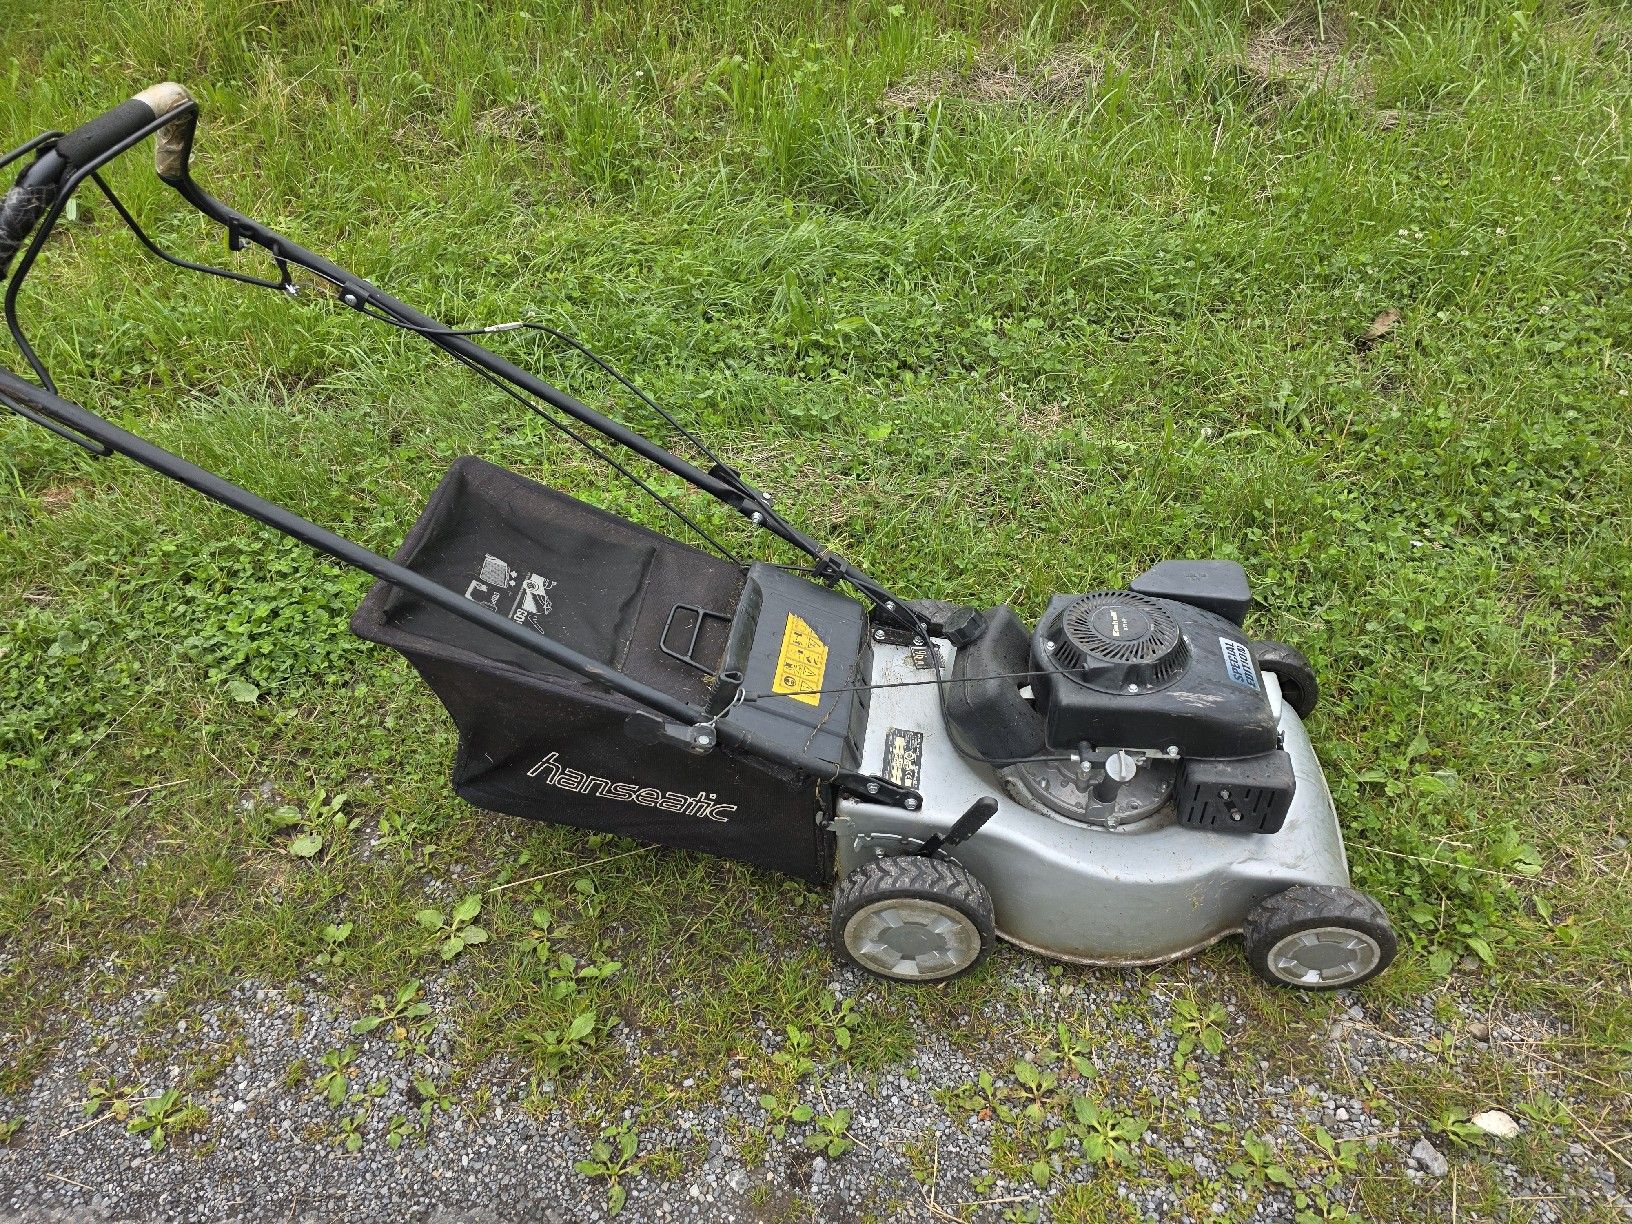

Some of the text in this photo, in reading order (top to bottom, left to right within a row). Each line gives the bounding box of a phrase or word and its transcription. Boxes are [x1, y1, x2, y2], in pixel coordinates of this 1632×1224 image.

[1224, 642, 1245, 683] SPECIAL
[1236, 645, 1256, 688] EDITION
[526, 751, 738, 823] hanseatic
